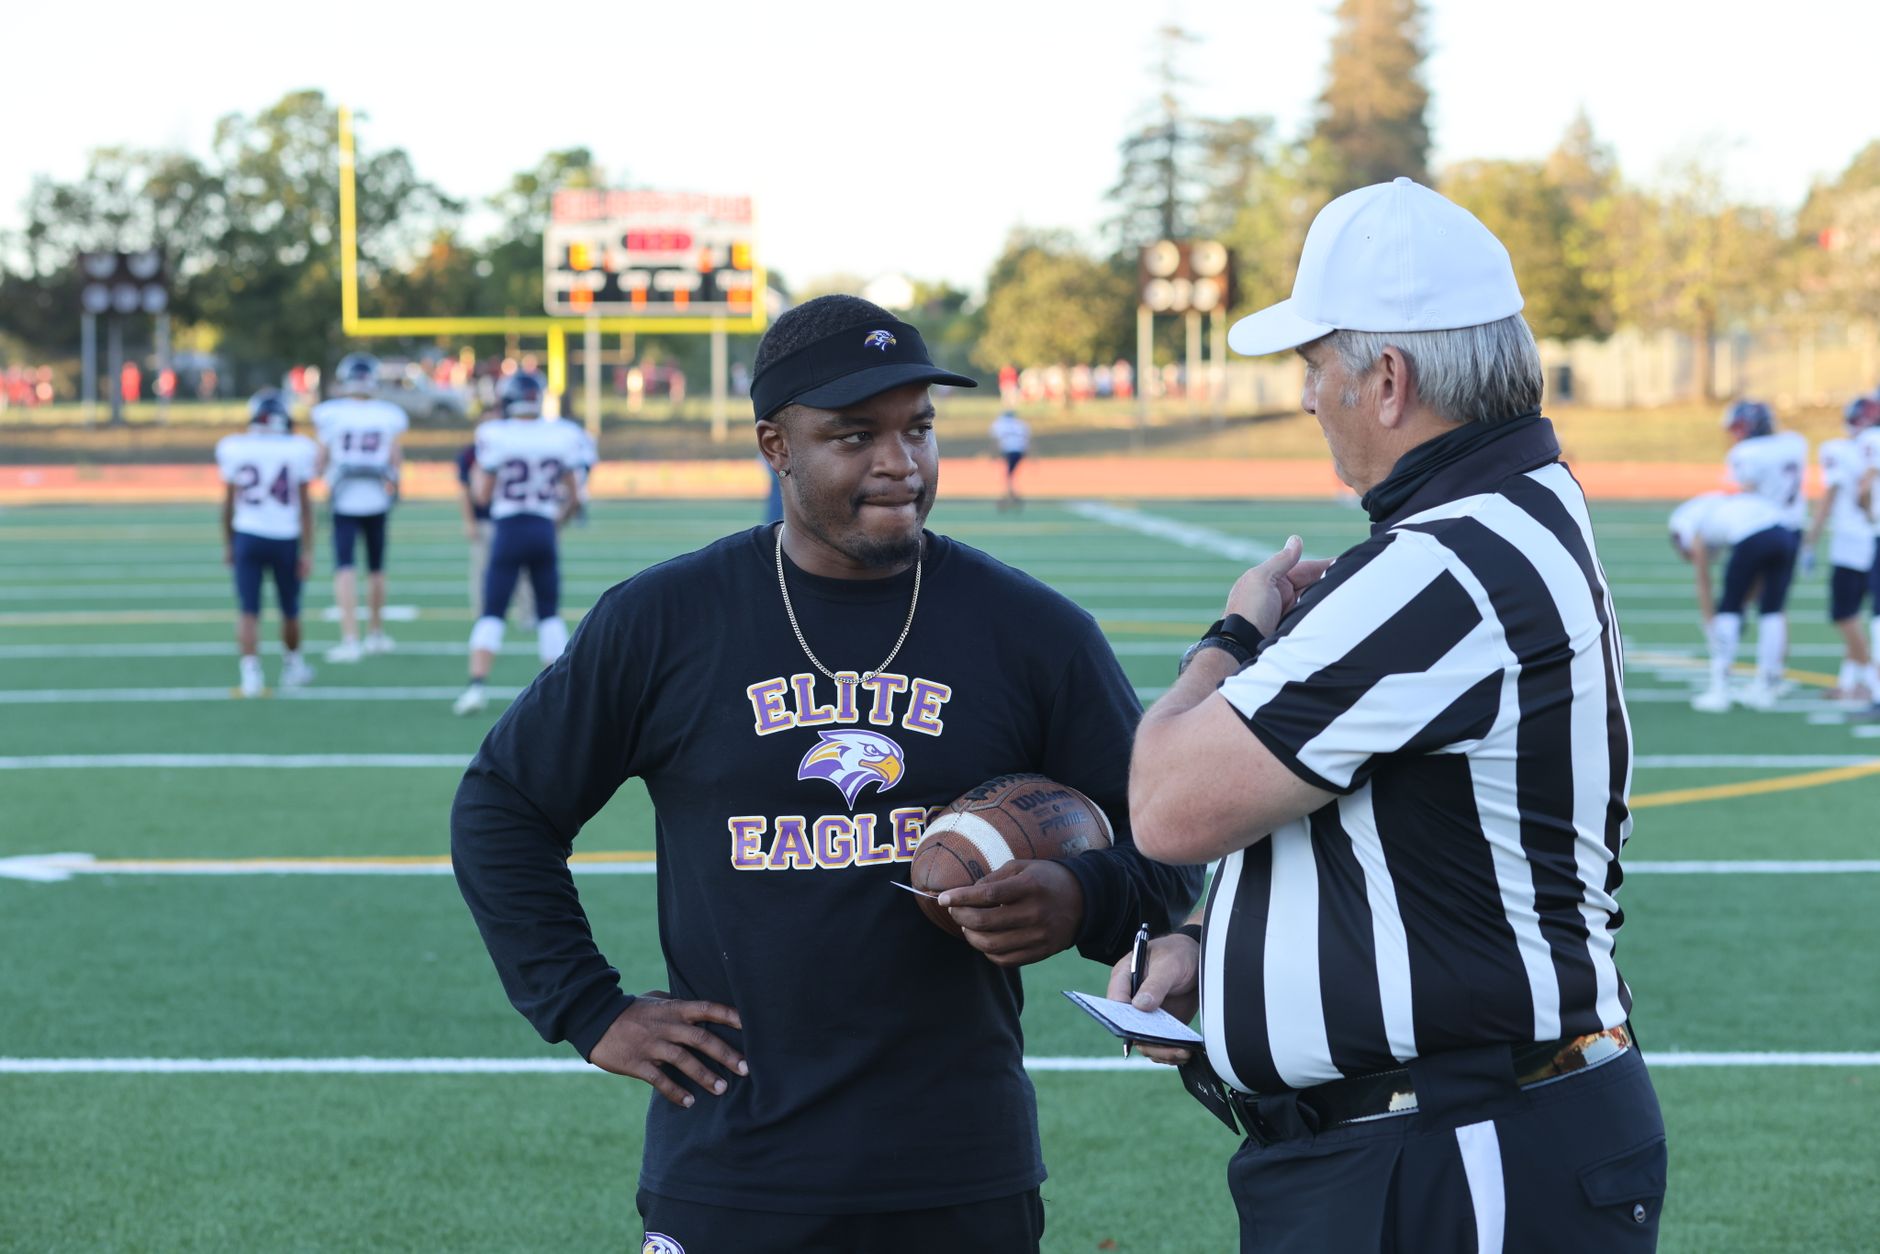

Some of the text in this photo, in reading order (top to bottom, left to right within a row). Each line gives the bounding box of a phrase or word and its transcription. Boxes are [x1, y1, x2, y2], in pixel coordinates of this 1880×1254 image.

[236, 463, 291, 506] 24
[747, 671, 952, 736] ELITE
[728, 807, 945, 870] EAGLE
